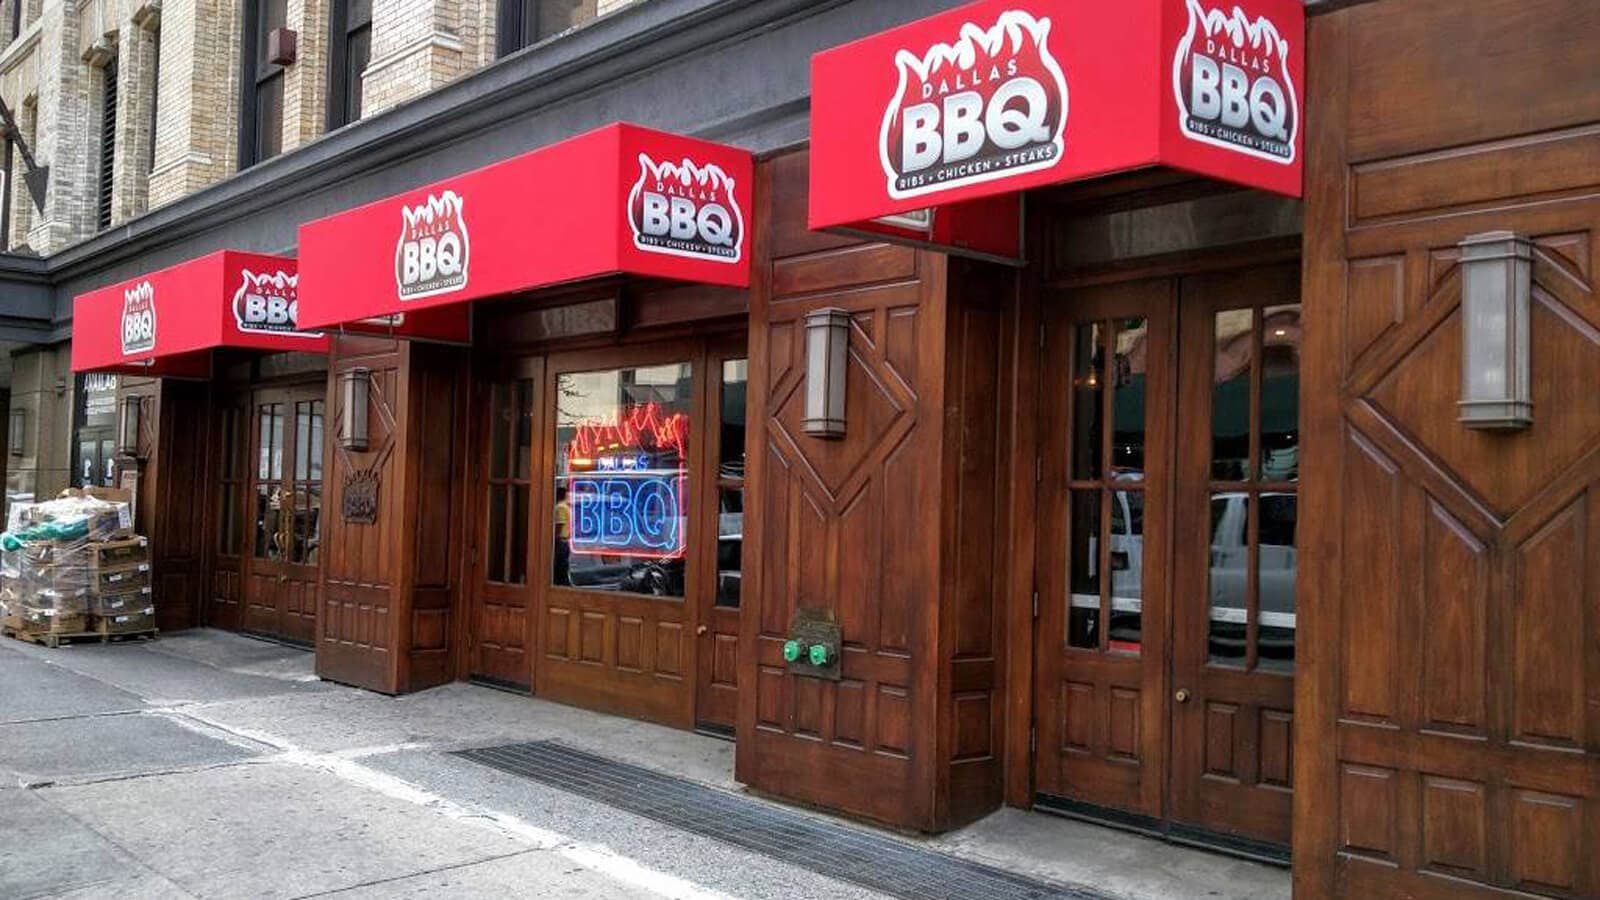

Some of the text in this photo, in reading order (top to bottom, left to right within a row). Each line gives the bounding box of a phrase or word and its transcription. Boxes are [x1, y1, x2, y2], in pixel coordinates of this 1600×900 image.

[1207, 39, 1270, 73] DALLAS
[922, 59, 1018, 99] DALLAS
[1191, 52, 1289, 142] BBQ
[902, 76, 1051, 174] BBQ
[1189, 119, 1289, 156] RIBS CHICKEN STEAKS
[899, 146, 1053, 189] RIBS CHICKEN STEAKS
[656, 181, 716, 201] DALLAS
[643, 191, 734, 248] BBQ
[403, 231, 461, 286] BBQ
[666, 239, 701, 252] CHICKEN
[255, 287, 297, 297] DALLA
[125, 309, 153, 343] BBQ
[571, 479, 678, 550] BBQ
